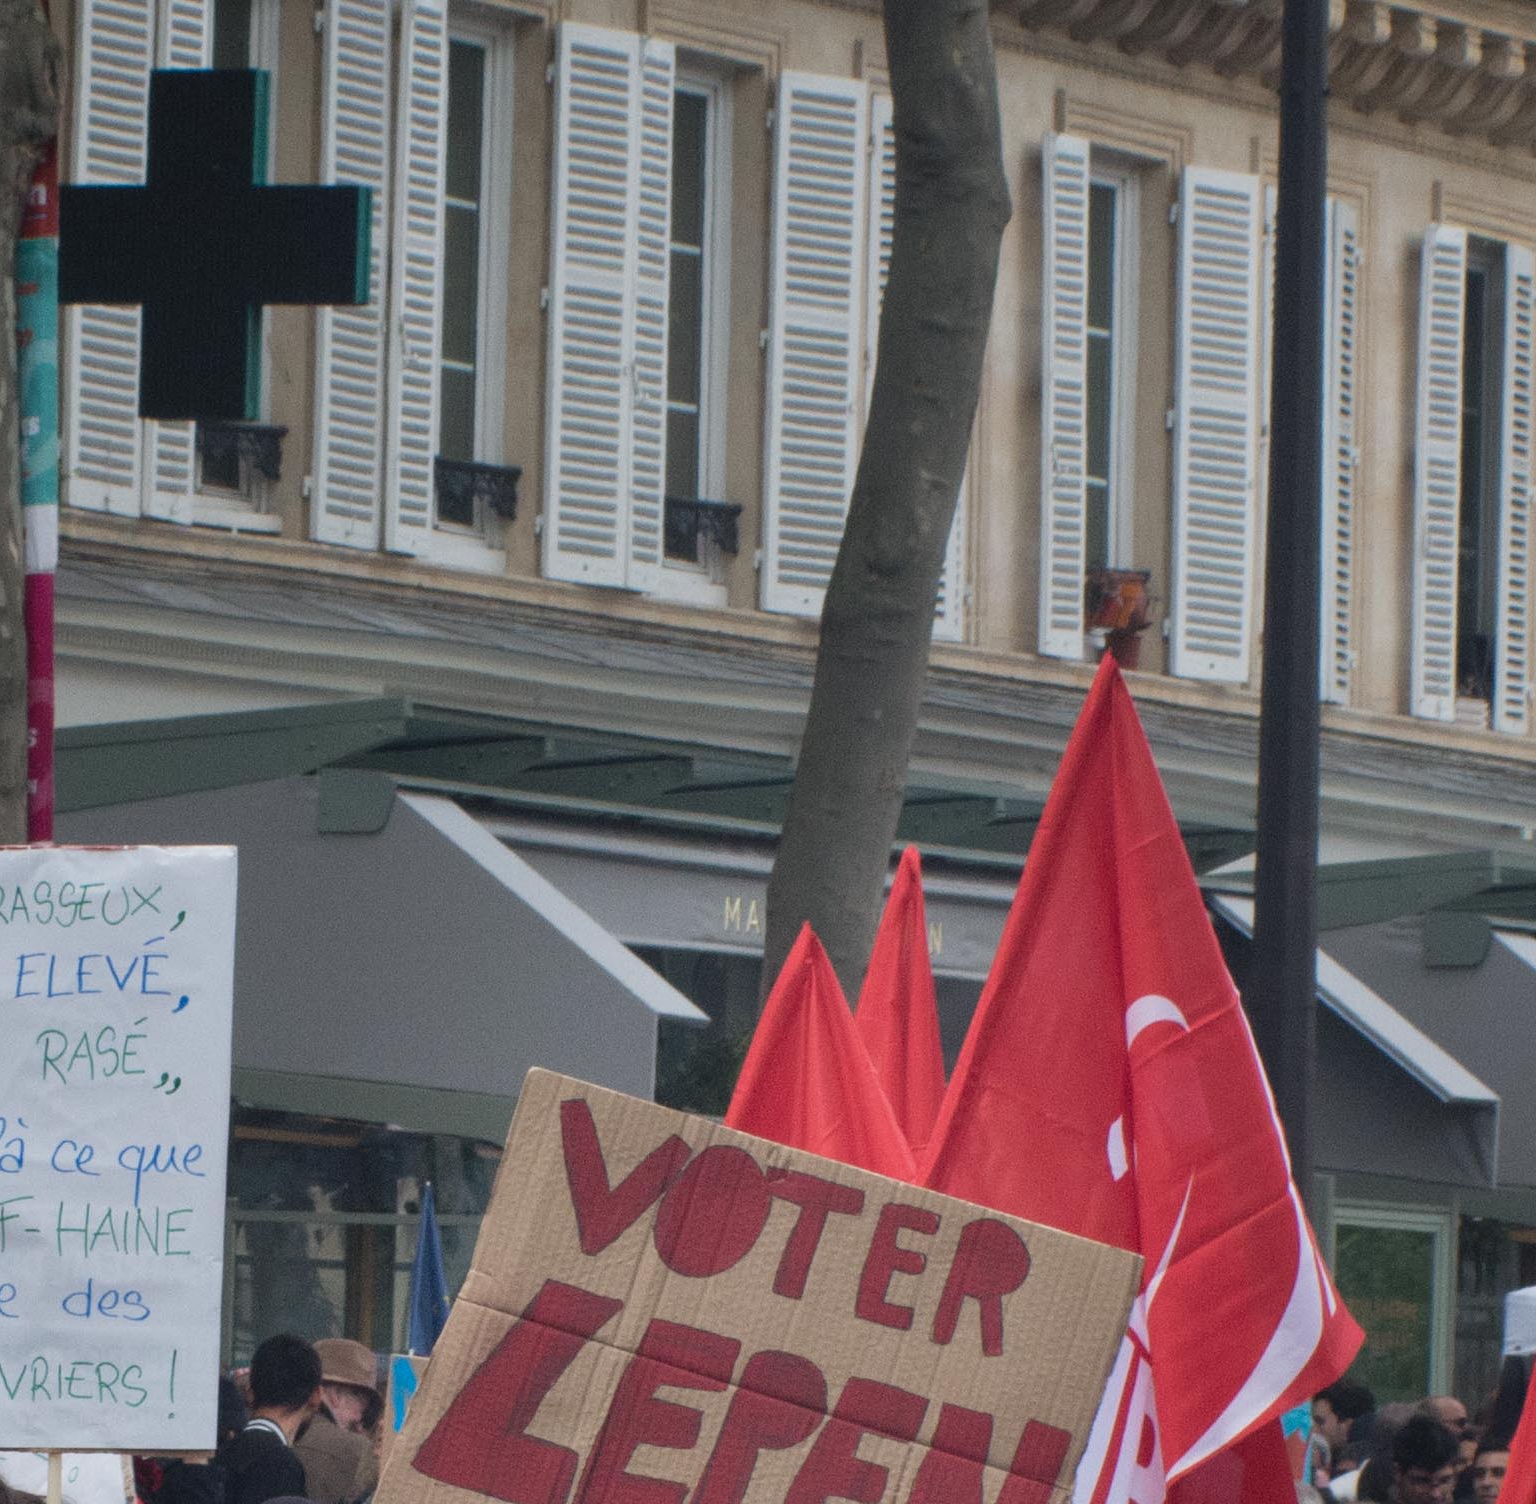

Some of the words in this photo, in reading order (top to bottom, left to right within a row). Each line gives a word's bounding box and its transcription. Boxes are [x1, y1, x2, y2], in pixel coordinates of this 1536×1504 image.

[51, 1138, 101, 1176] ce
[118, 1141, 206, 1210] que
[560, 1097, 1032, 1358] VOTER
[62, 1278, 151, 1322] des
